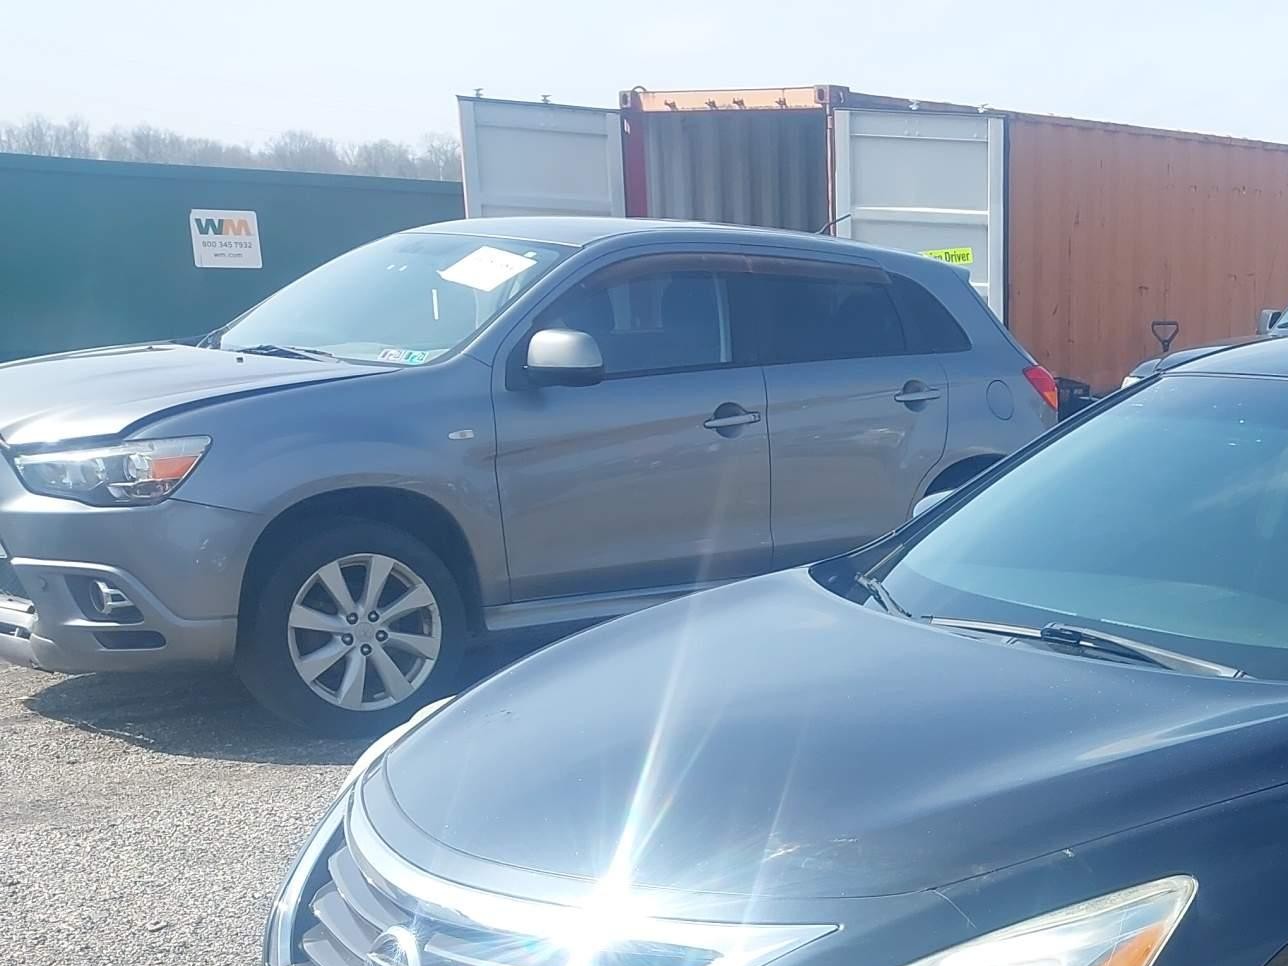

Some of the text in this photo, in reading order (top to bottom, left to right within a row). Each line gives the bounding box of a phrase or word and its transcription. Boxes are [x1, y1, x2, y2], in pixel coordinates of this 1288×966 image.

[195, 217, 252, 236] WM
[219, 241, 233, 249] 345
[944, 251, 970, 263] Driver
